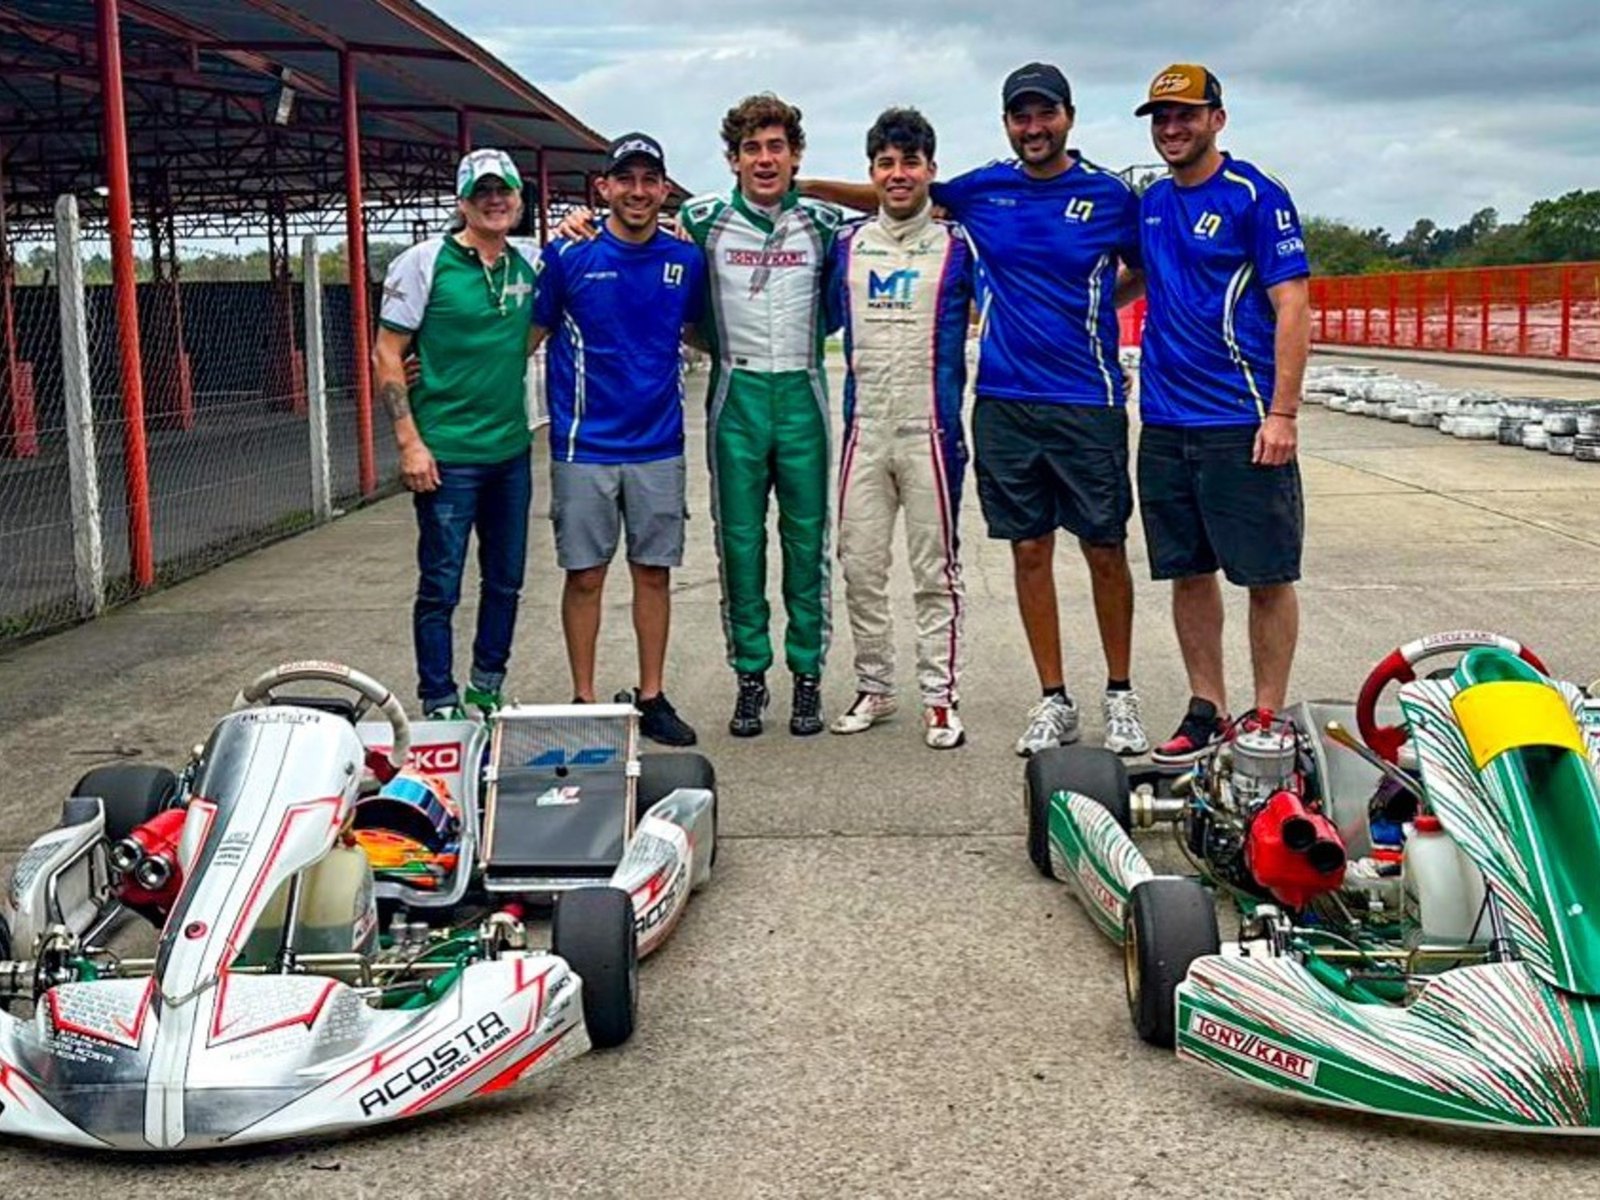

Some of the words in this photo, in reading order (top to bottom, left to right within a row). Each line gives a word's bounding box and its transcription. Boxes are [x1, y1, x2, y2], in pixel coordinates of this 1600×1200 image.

[869, 270, 919, 300] MT
[359, 1011, 504, 1116] ACOSTA
[421, 1055, 471, 1091] RACING
[475, 1026, 512, 1054] TEAM
